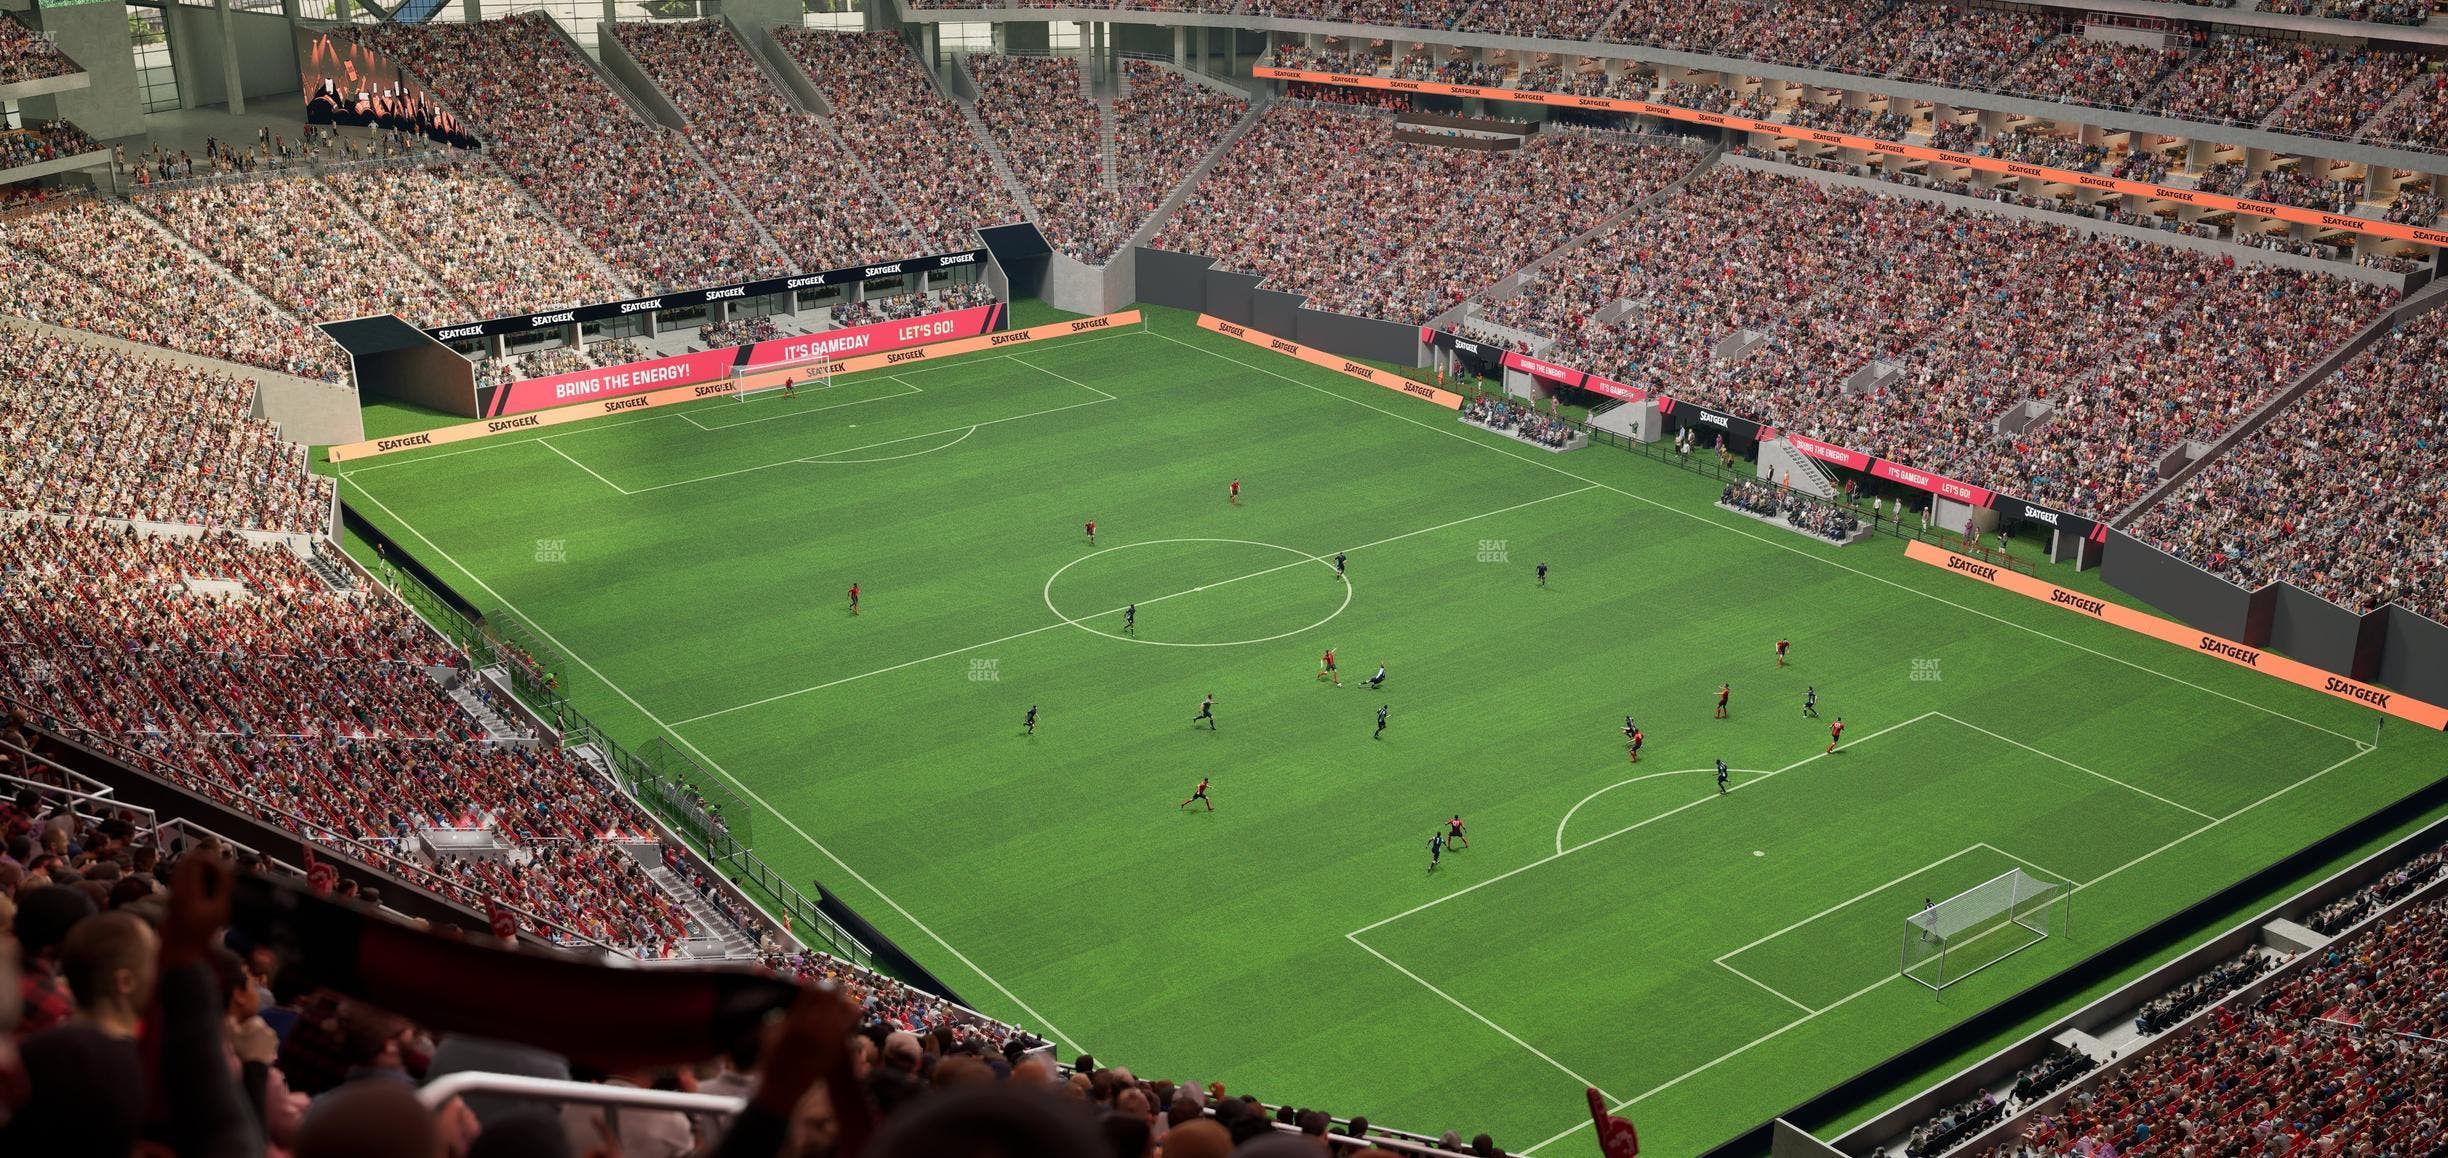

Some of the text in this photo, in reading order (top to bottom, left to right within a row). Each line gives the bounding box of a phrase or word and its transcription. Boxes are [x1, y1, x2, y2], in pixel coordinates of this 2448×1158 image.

[1273, 70, 1301, 79] SEATGEEK
[1331, 75, 1359, 84] SEATGEEK
[1390, 80, 1419, 90] SEATGEEK
[1451, 86, 1481, 96] SEATGEEK
[1514, 92, 1545, 102] SEATGEEK
[1579, 98, 1611, 108] SEATGEEK
[1645, 104, 1670, 115] SEATGEEK
[1698, 113, 1725, 124] SEATGEEK
[1754, 122, 1782, 134] SEATGEEK
[1813, 132, 1842, 144] SEATGEEK
[1874, 142, 1905, 155] SEATGEEK
[1939, 153, 1971, 165] SEATGEEK
[2007, 164, 2041, 177] SEATGEEK
[2079, 176, 2116, 189] SEATGEEK
[2156, 188, 2193, 202] SEATGEEK
[2236, 201, 2277, 216] SEATGEEK
[2322, 215, 2365, 230] SEATGEEK
[940, 252, 975, 266] SEATGEEK
[865, 263, 901, 277] SEATGEEK
[787, 274, 825, 288] SEATGEEK
[706, 286, 745, 301] SEATGEEK
[621, 299, 662, 313] SEATGEEK
[532, 311, 575, 327] SEATGEEK
[1072, 317, 1109, 332] SEATGEEK
[438, 324, 484, 341] SEATGEEK
[1219, 322, 1245, 338] SEATGEEK
[784, 320, 954, 360] IT'S GAMEDAY LET'S GO!
[991, 330, 1030, 346] SEATGEEK
[1271, 339, 1299, 355] SEATGEEK
[1455, 338, 1479, 355] SEATGEEK
[888, 349, 925, 363] SEATGEEK
[1344, 362, 1374, 380] SEATGEEK
[556, 363, 691, 399] BRING THE ENERGY!
[695, 382, 737, 397] SEATGEEK
[1403, 381, 1435, 399] SEATGEEK
[604, 396, 649, 413] SEATGEEK
[488, 414, 539, 432] SEATGEEK
[1700, 411, 1729, 429] SEATGEEK
[377, 433, 432, 452] SEATGEEK
[1814, 444, 1826, 456] THE
[1900, 469, 1930, 487] GAMEDAY
[2024, 505, 2058, 526] SEATGEEK
[1947, 555, 1998, 582] SEATGEEK
[2051, 588, 2106, 617] SEATGEEK
[2199, 636, 2261, 667] SEATGEEK
[2324, 676, 2391, 709] SEATGEEK
